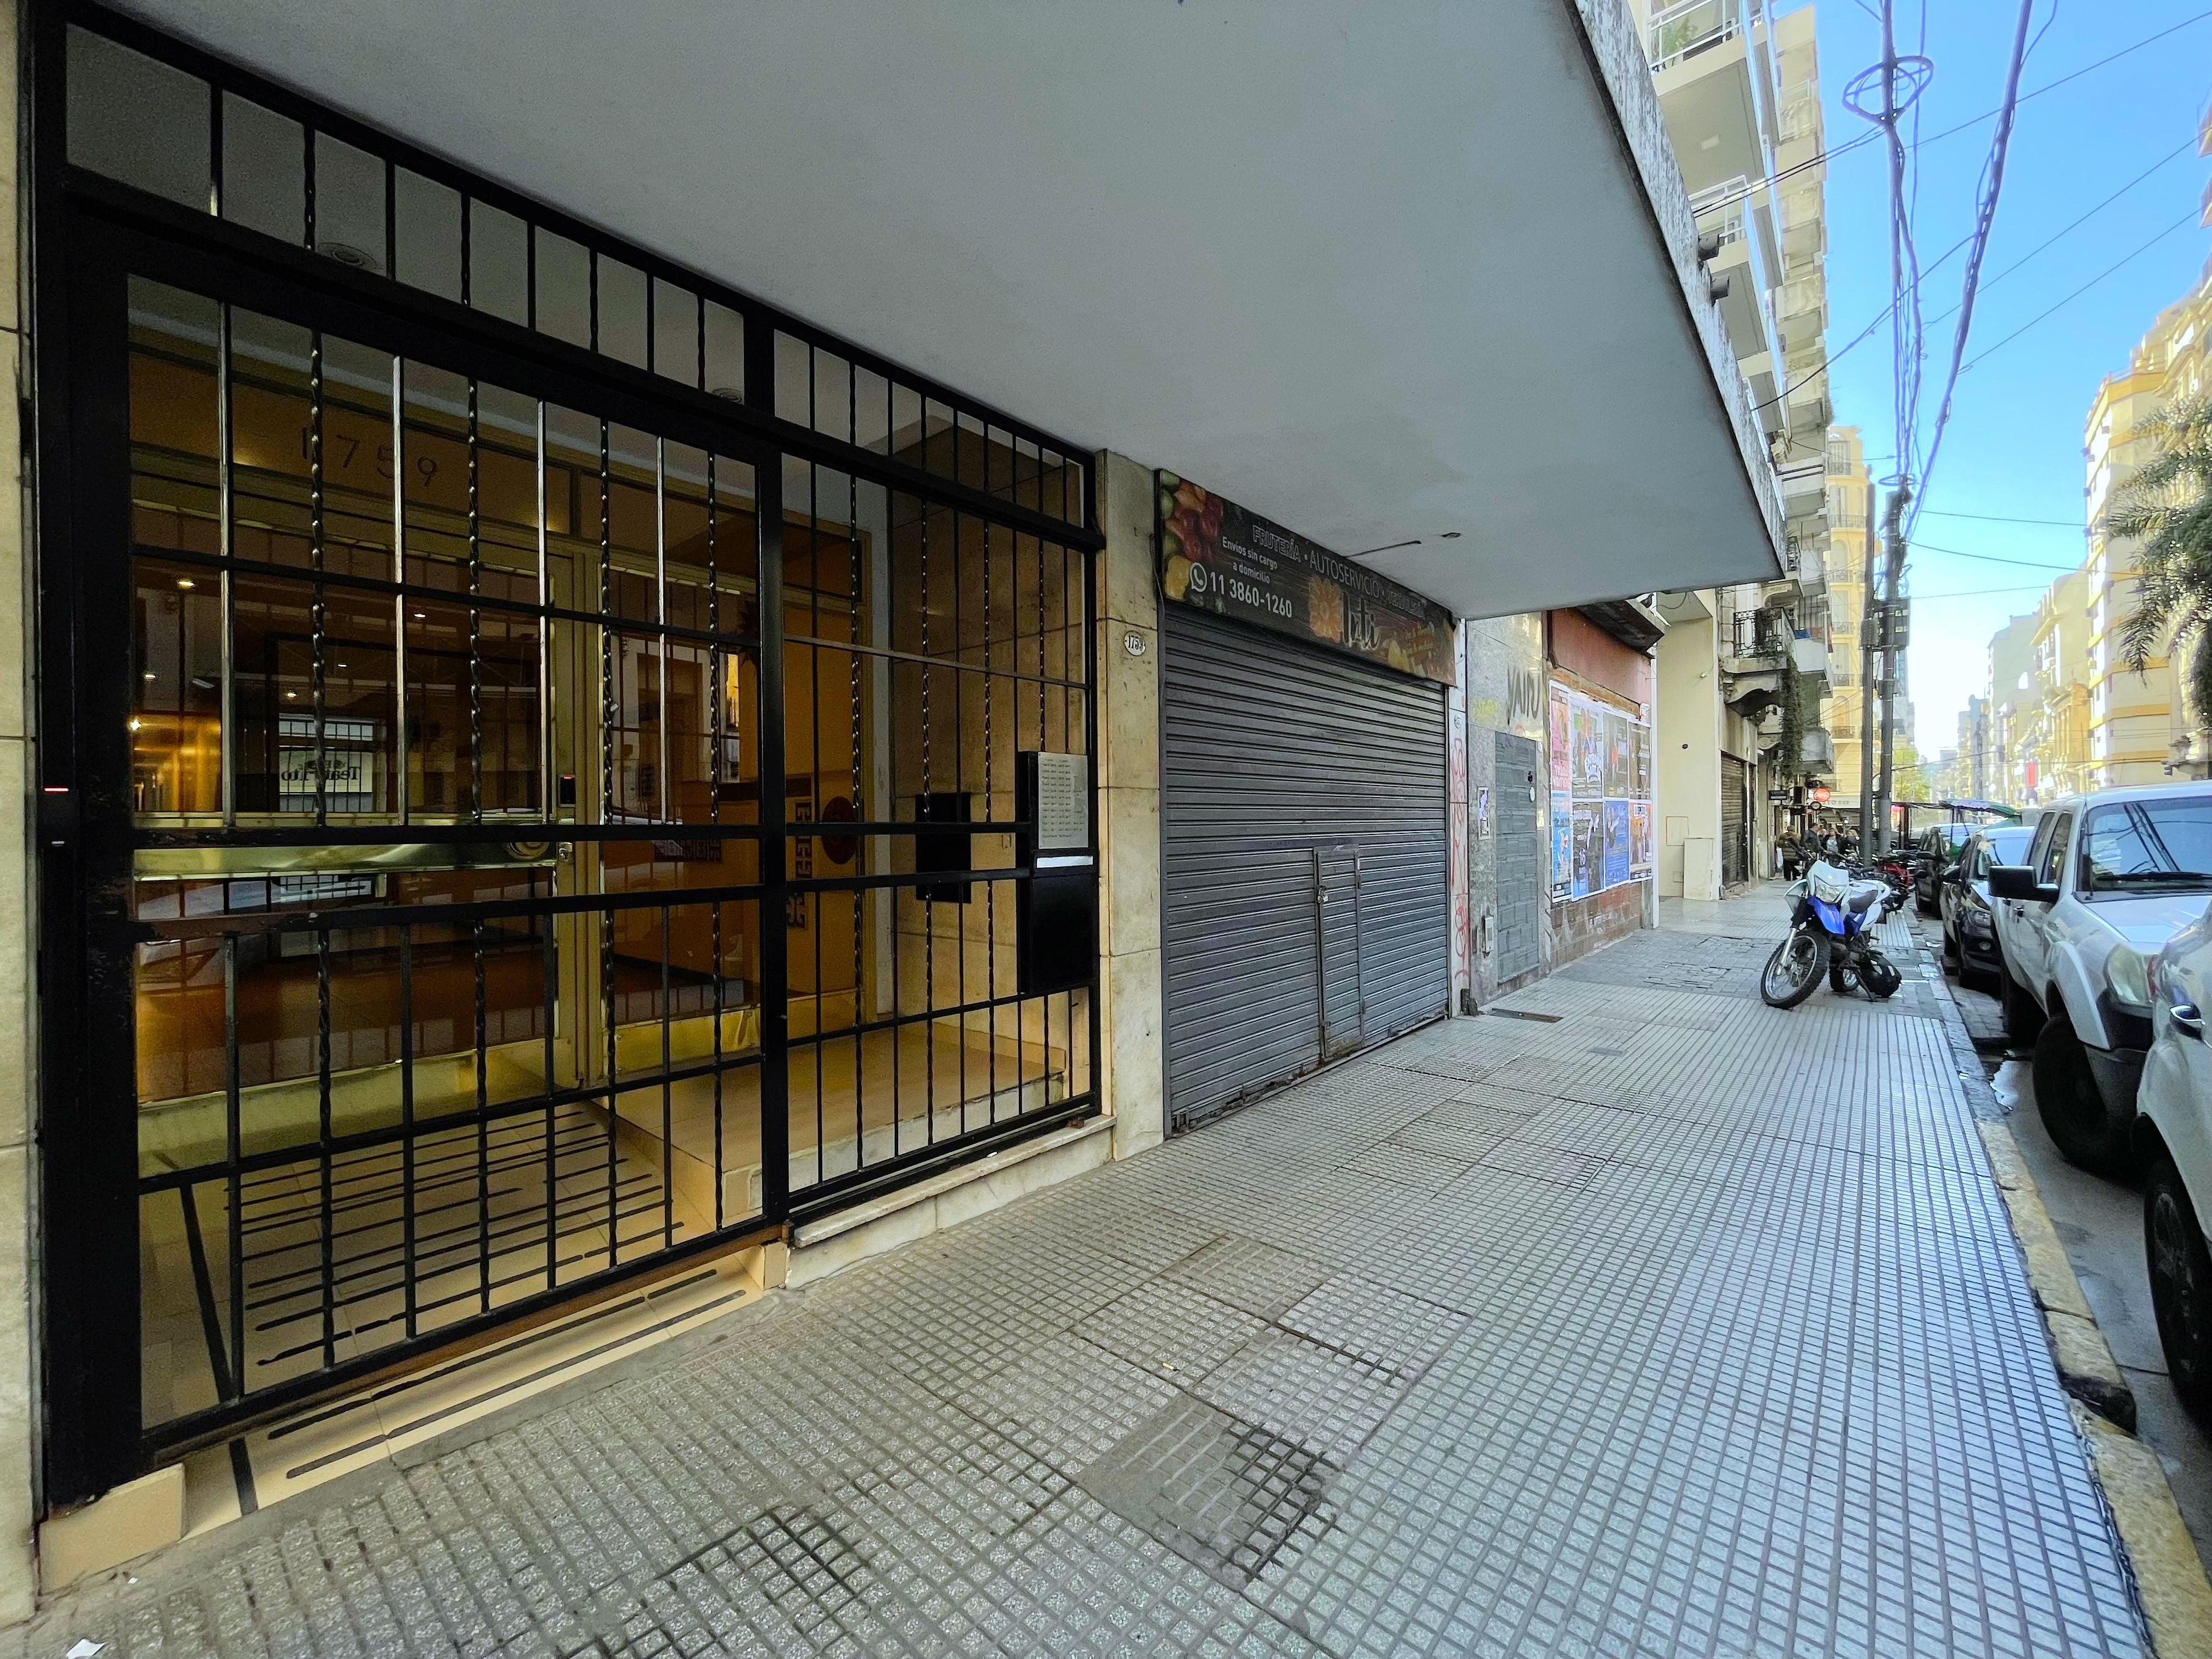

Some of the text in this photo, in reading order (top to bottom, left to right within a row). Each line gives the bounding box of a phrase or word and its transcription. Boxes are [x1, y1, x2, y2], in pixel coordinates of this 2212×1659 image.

[1248, 549, 1258, 561] sin
[1259, 556, 1278, 570] cargo
[1233, 562, 1270, 584] a domicilio
[1310, 550, 1379, 598] AUTOSERVICIO
[1210, 571, 1292, 618] 11 3860-1260
[1128, 635, 1143, 652] 1759
